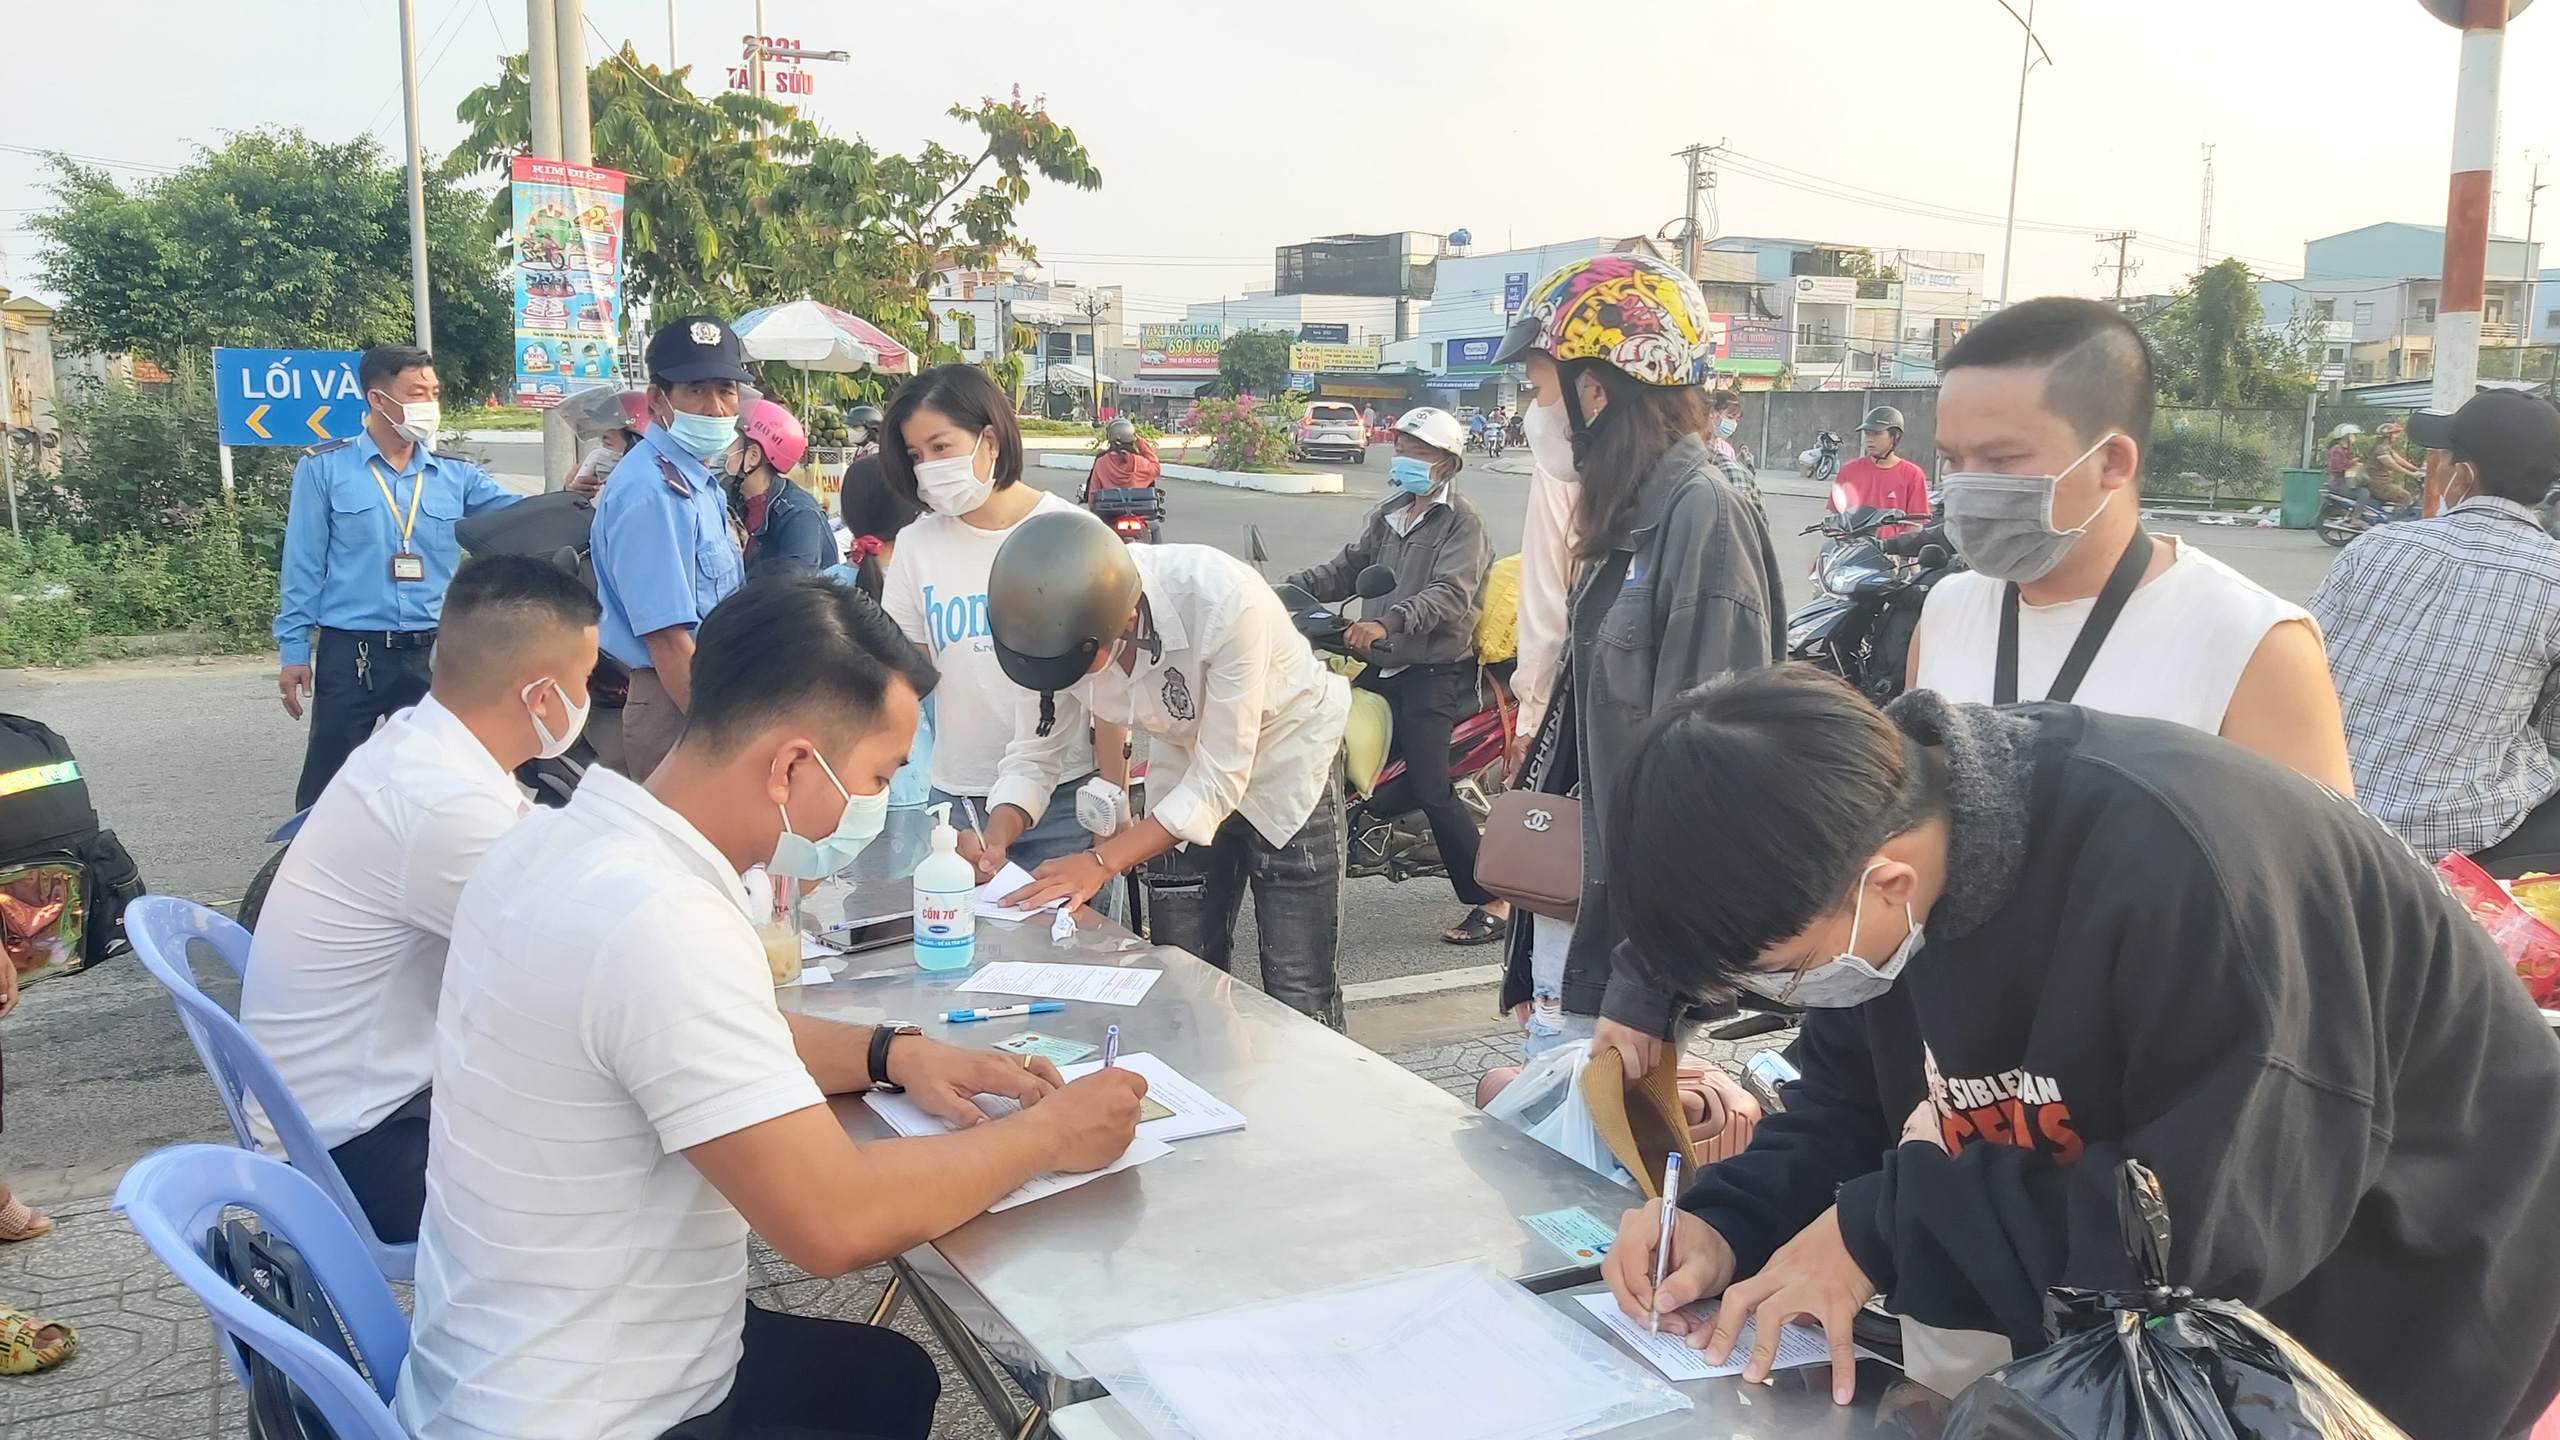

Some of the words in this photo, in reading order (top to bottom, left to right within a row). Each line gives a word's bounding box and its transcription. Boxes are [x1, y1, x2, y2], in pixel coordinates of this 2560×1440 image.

[776, 65, 814, 95] SỬU
[532, 164, 565, 176] KIM
[567, 167, 607, 183] ĐIỆP
[1142, 325, 1166, 336] TAXI
[1167, 337, 1193, 356] 690
[1194, 337, 1219, 356] 690
[242, 356, 301, 400] LỐI
[311, 362, 363, 400] VÀ
[774, 905, 790, 913] TEA
